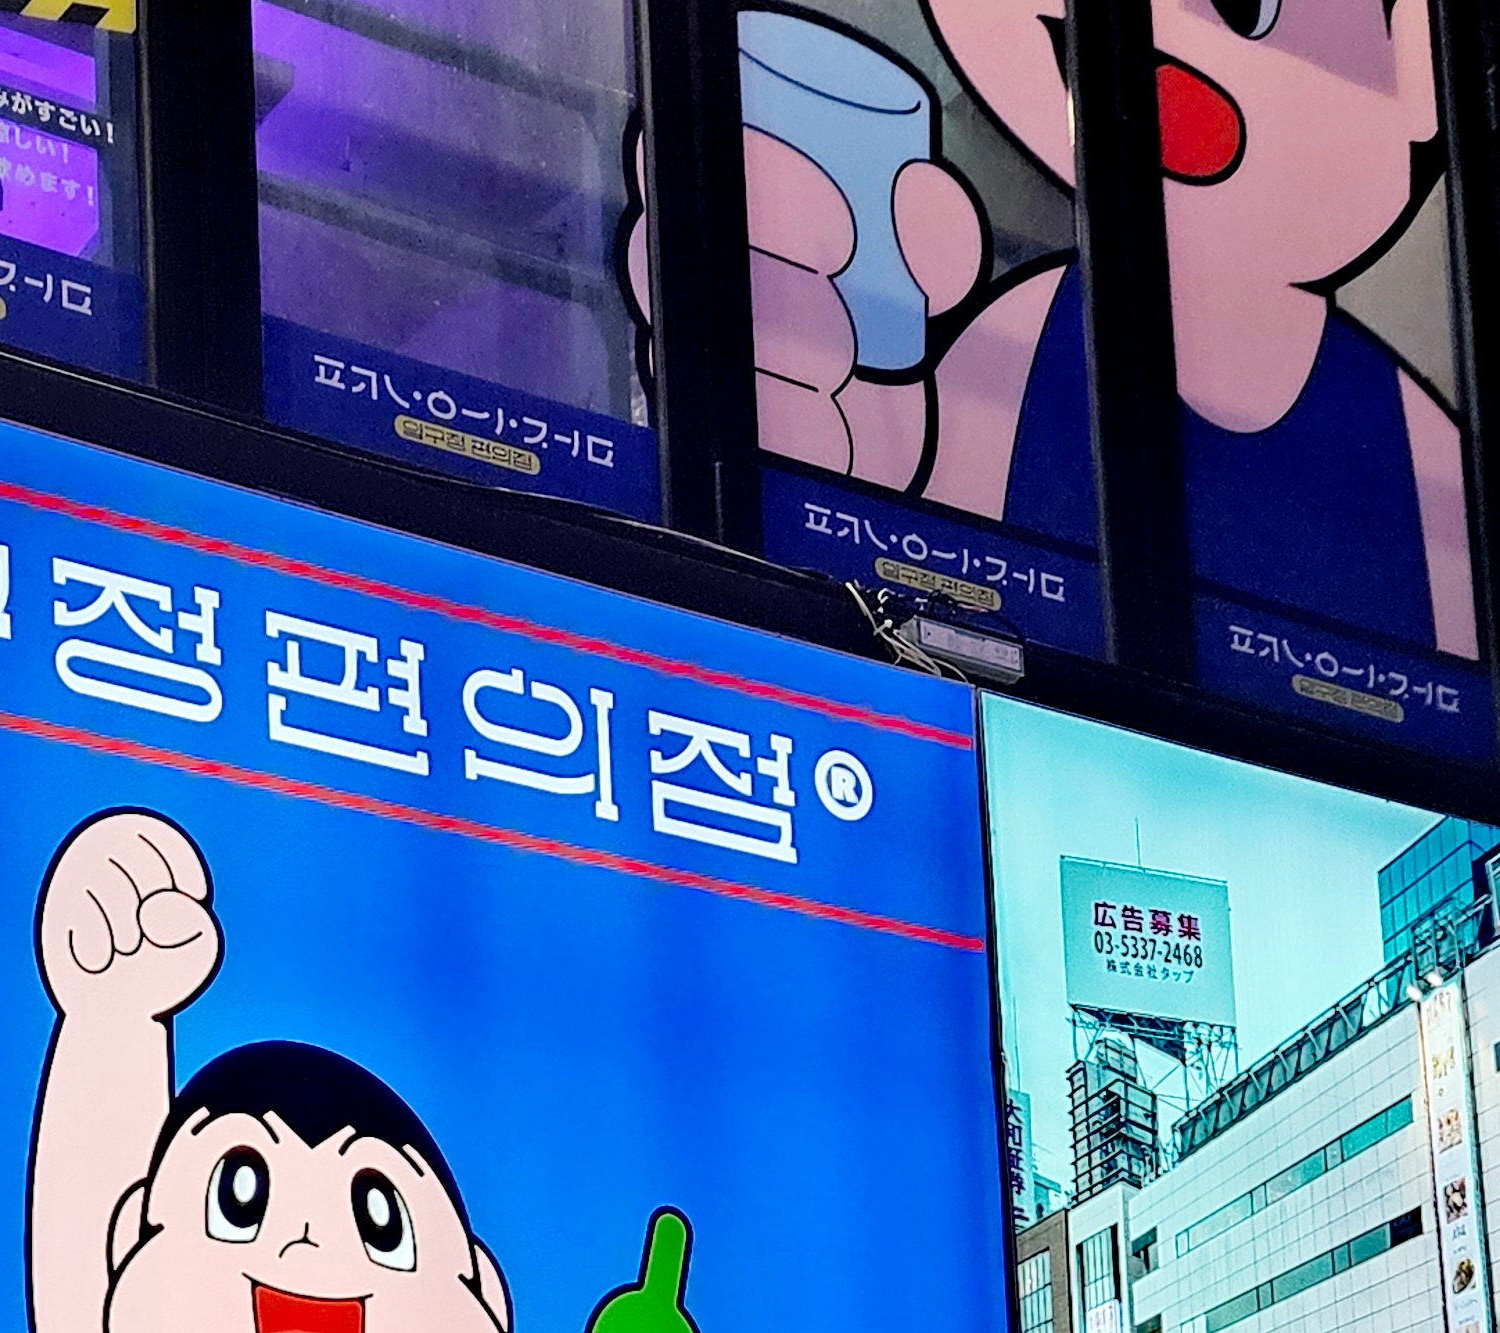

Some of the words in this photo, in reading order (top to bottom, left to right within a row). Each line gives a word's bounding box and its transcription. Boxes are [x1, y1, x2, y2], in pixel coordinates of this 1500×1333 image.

[1094, 901, 1201, 941] 広告募集
[1094, 930, 1202, 968] 03-5337-2468
